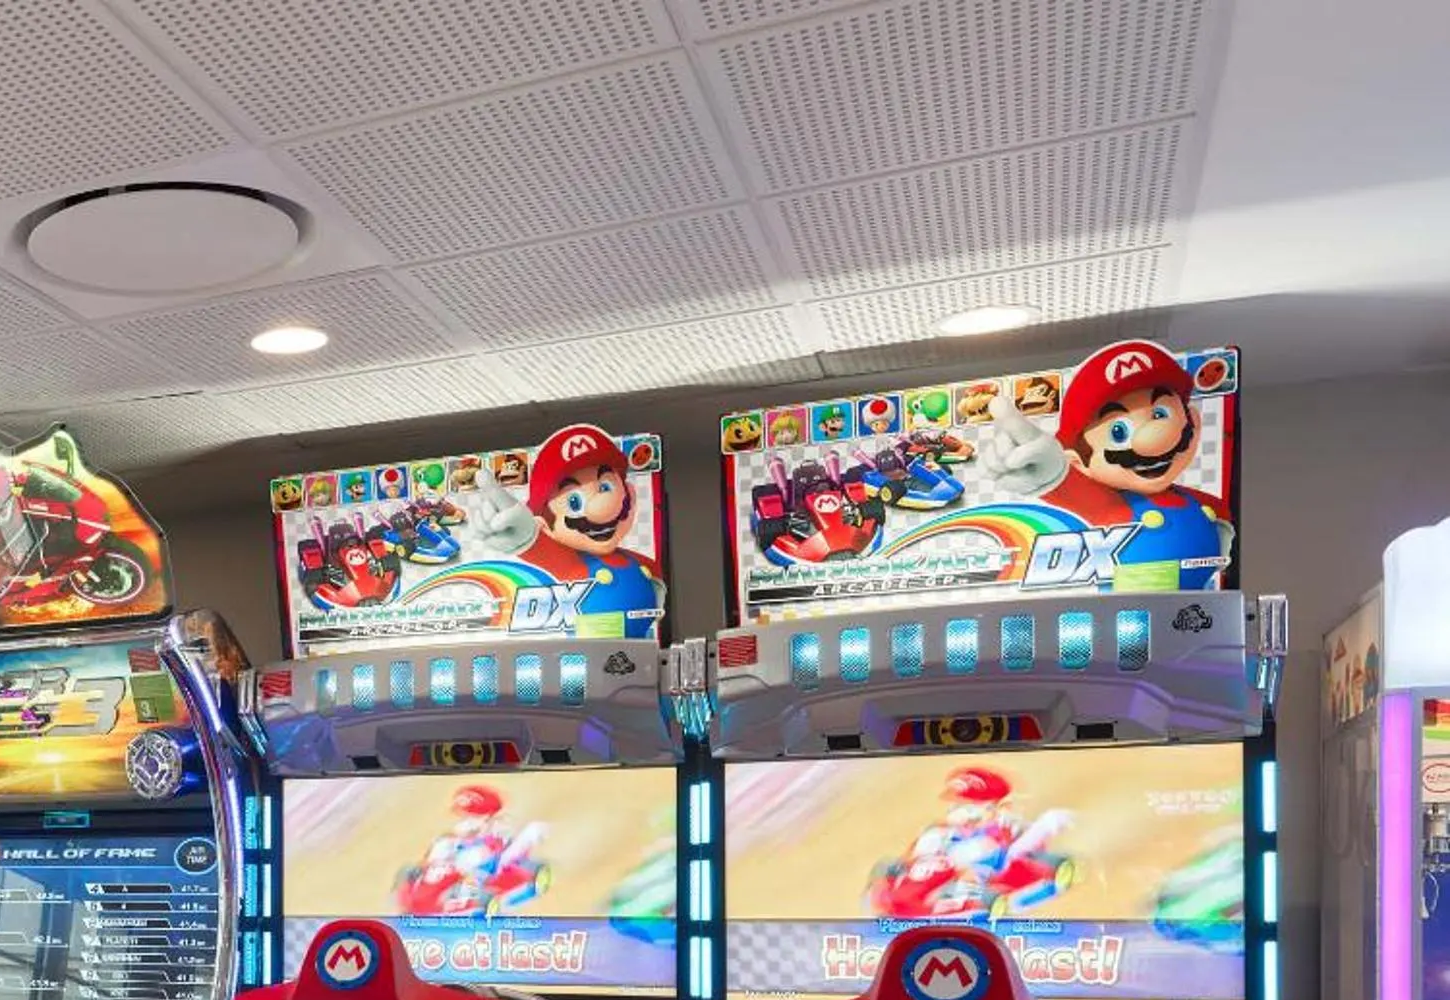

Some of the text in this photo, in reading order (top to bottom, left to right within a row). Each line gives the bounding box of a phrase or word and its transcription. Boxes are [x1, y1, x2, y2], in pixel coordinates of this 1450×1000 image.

[1021, 521, 1144, 592] DX
[508, 580, 595, 634] DX
[52, 676, 127, 737] 3
[3, 847, 158, 860] HALL OF FAME
[327, 943, 367, 972] M
[403, 928, 589, 973] re at last!
[822, 934, 1124, 984] He last!
[917, 955, 974, 989] M
